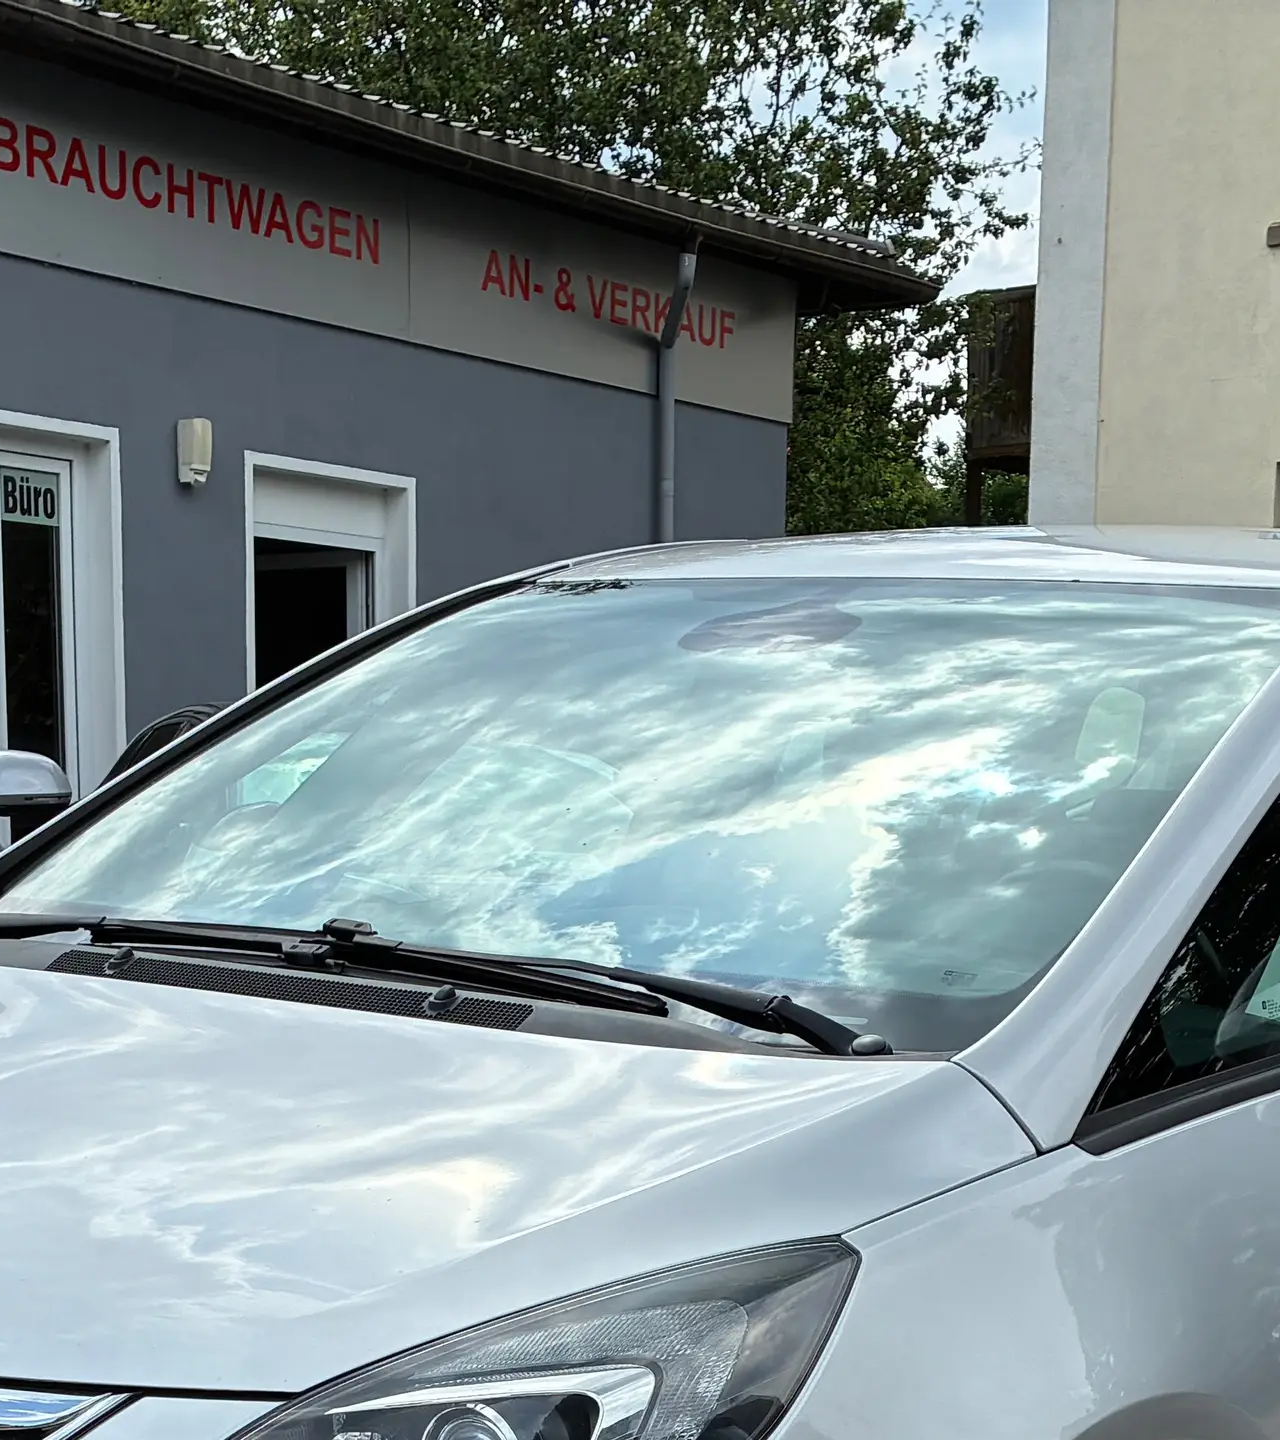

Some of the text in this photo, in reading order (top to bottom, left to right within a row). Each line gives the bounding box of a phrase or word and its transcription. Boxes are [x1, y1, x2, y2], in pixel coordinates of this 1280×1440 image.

[481, 249, 543, 302] AN-
[554, 267, 576, 312] &
[2, 474, 56, 519] Büro
